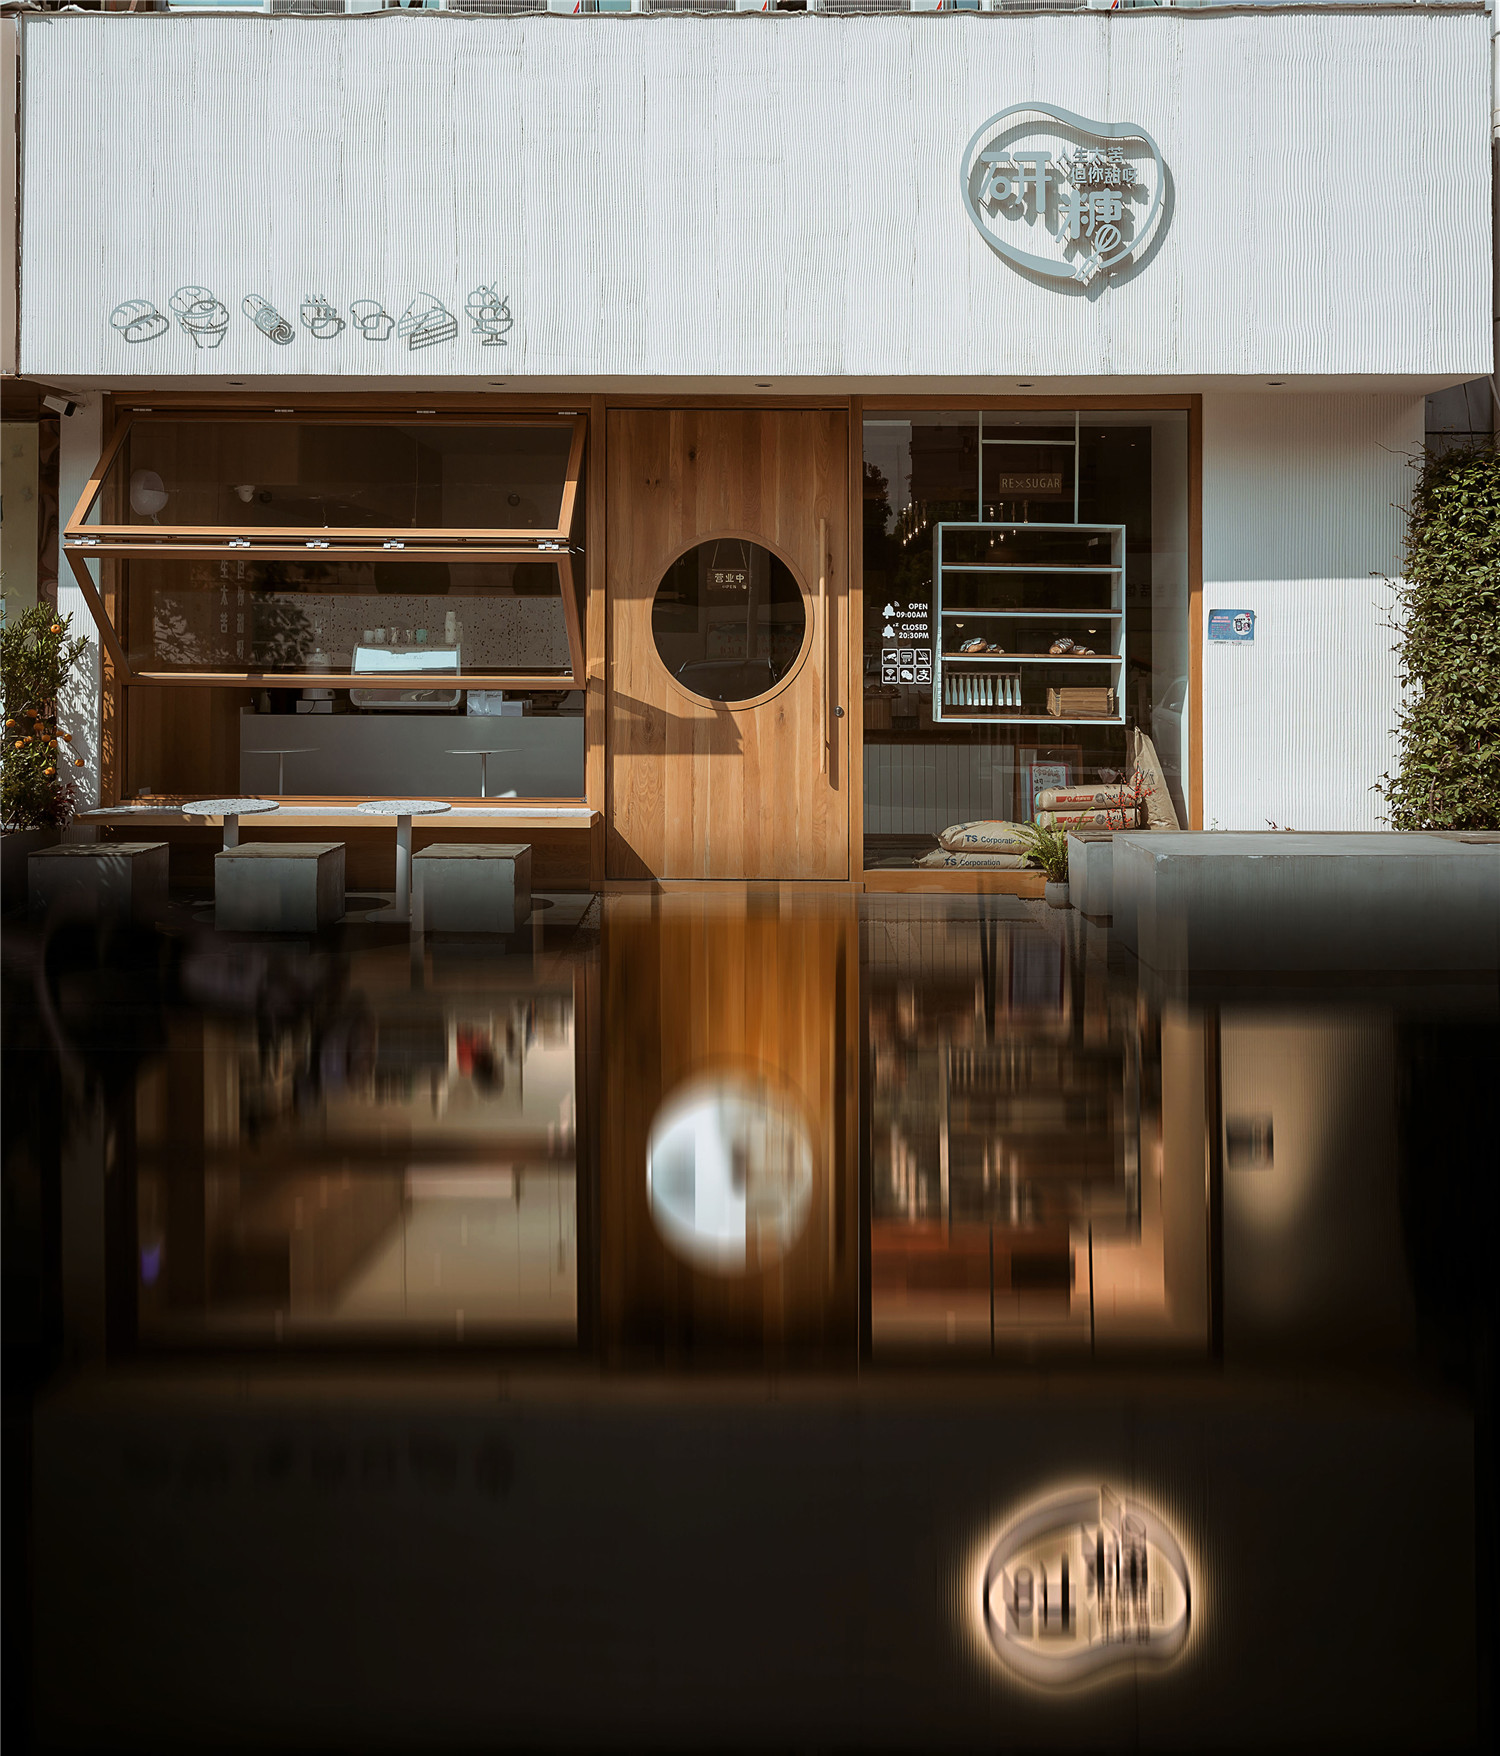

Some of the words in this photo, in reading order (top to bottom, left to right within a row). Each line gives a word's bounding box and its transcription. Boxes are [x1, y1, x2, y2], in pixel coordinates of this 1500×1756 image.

[1057, 146, 1124, 165] 人生太苦
[1070, 167, 1138, 185] 但你甜呀
[1025, 478, 1060, 489] SUGAR
[714, 573, 745, 583] 营业中
[965, 835, 978, 843] TS
[944, 858, 957, 866] TS
[959, 859, 1001, 867] Corporation
